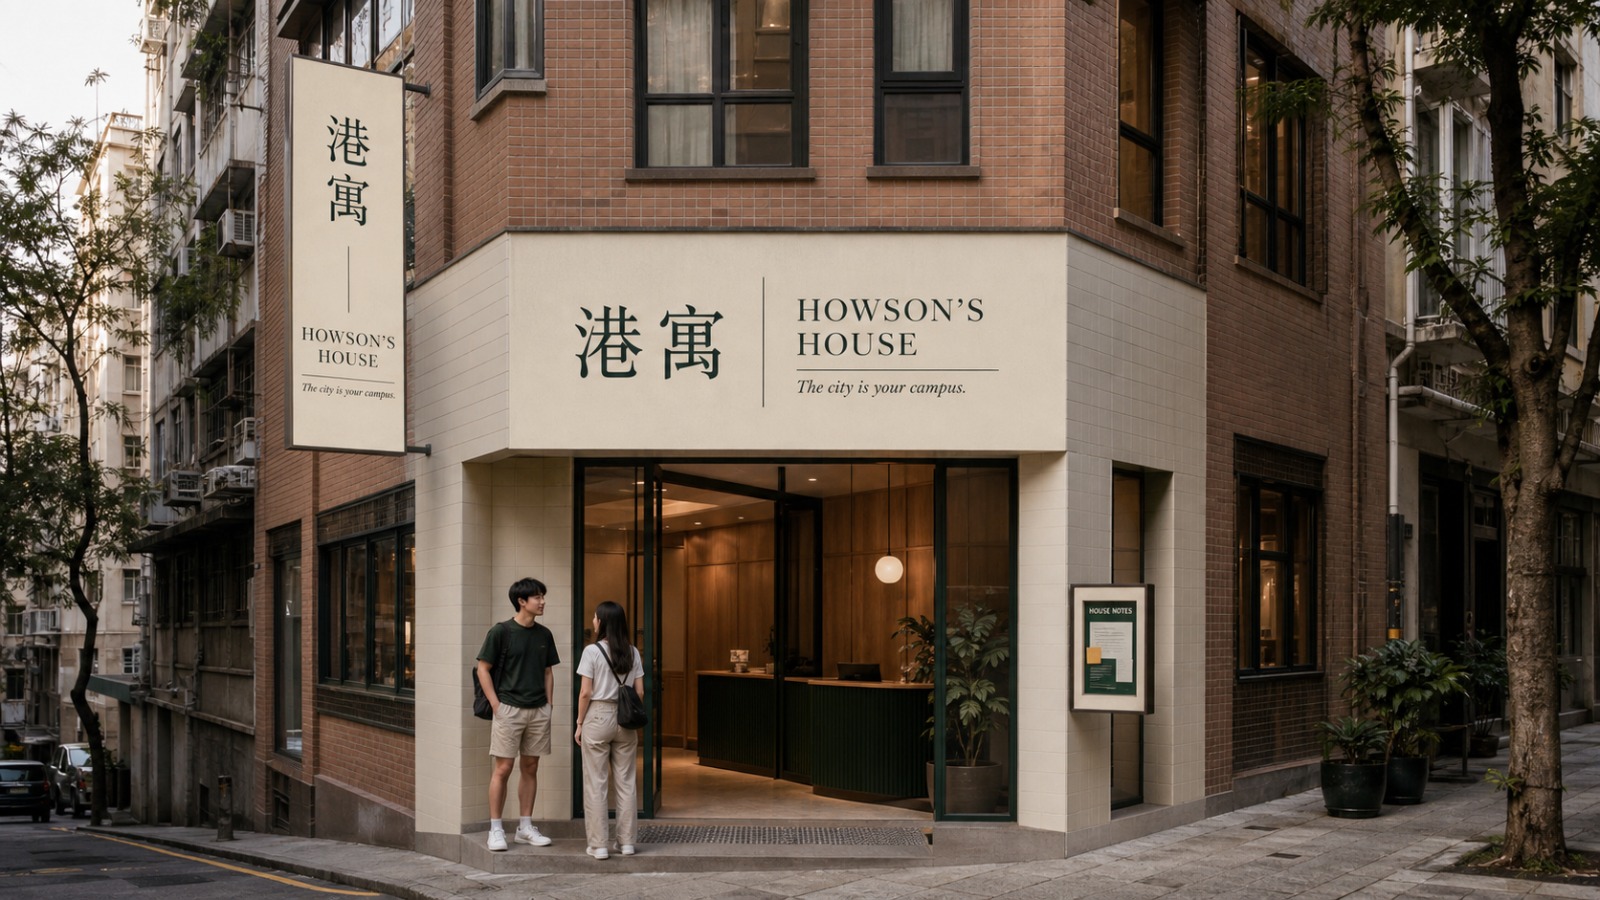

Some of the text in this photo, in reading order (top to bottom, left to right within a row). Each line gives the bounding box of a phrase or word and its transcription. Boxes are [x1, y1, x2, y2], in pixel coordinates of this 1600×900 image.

[327, 115, 370, 226] 港寓
[798, 298, 984, 322] HOWSON’S
[302, 326, 395, 350] HOWSON’S
[575, 304, 724, 380] 港寓
[797, 332, 918, 356] HOUSE
[318, 349, 378, 368] HOUSE
[302, 383, 395, 400] The city is your campus.
[797, 379, 966, 398] The city is your campus.
[1089, 607, 1133, 615] HOUSE NOTES
